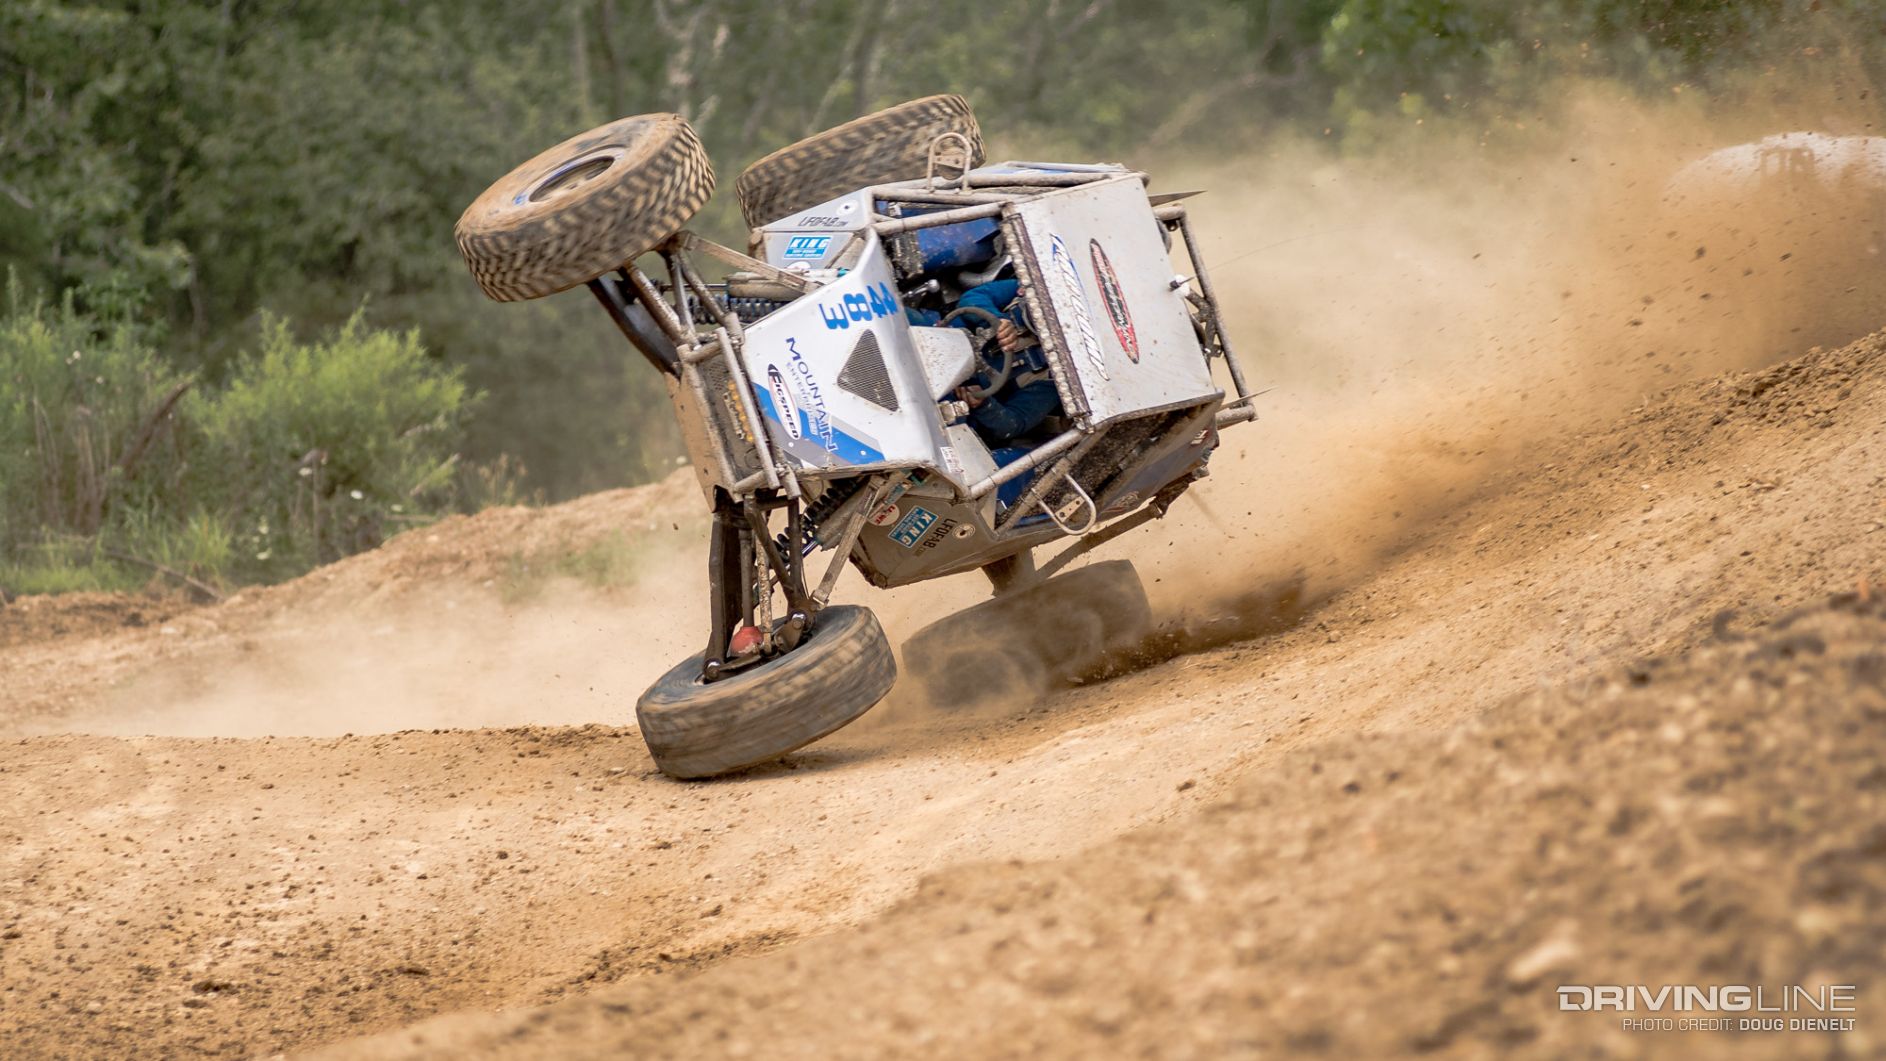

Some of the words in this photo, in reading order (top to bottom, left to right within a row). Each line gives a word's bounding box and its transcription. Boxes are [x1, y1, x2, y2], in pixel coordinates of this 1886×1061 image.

[789, 238, 831, 249] KING
[768, 370, 799, 439] FIGSPEED
[786, 337, 838, 451] MOUNTAIN
[901, 511, 933, 547] KING
